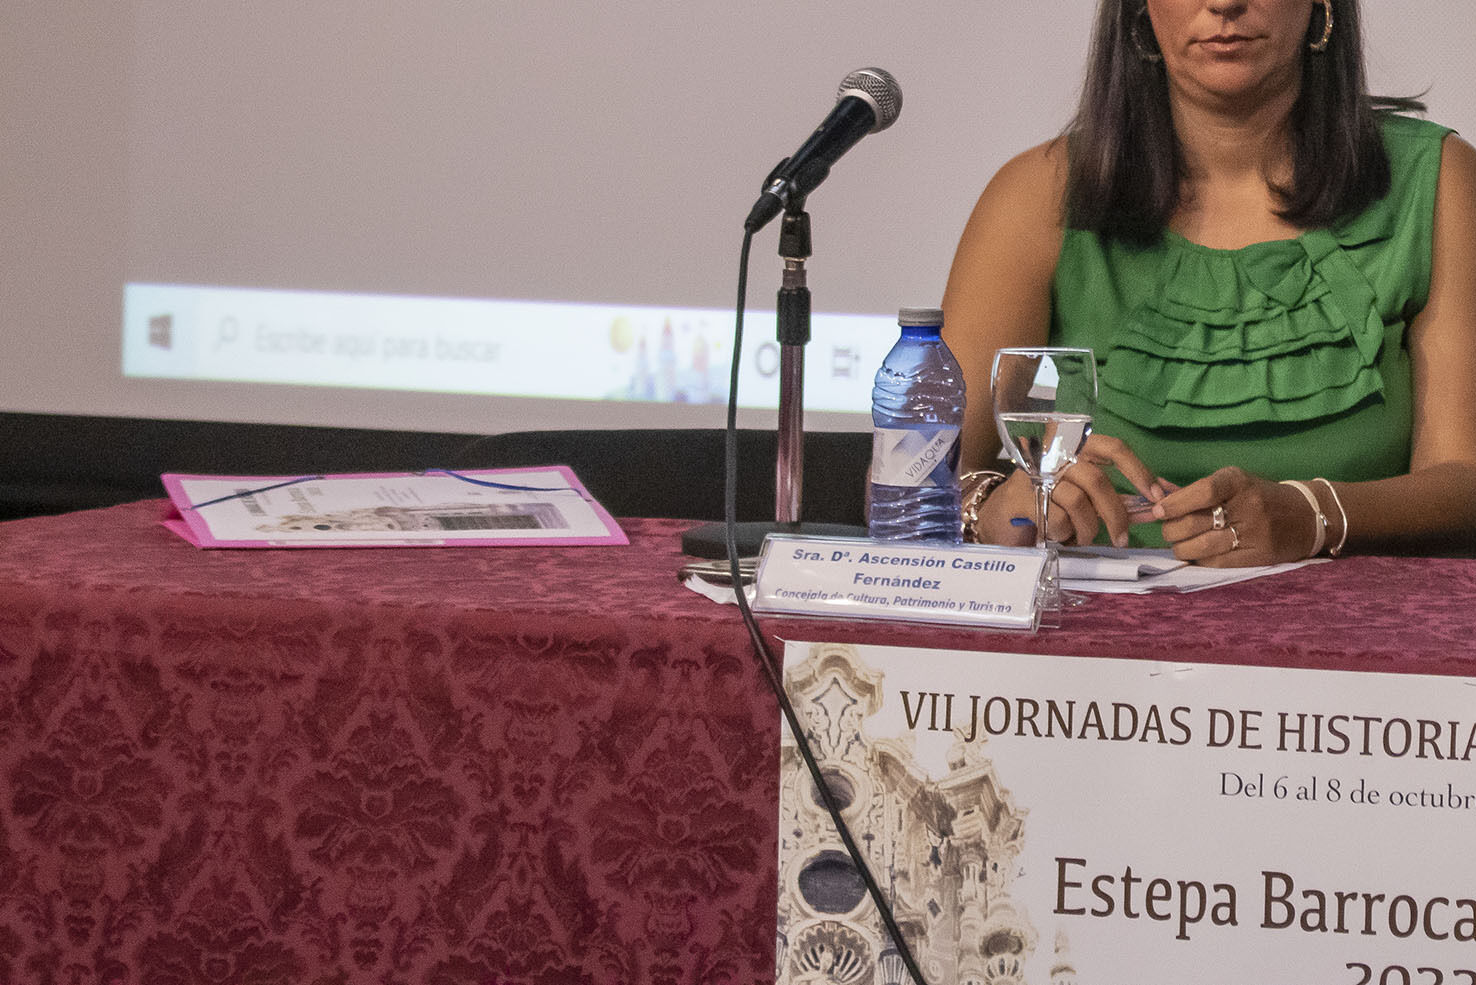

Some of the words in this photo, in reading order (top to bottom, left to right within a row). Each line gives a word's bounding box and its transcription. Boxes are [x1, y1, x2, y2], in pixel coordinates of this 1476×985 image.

[792, 548, 825, 561] Sra.
[858, 552, 945, 569] Ascensión
[951, 557, 1016, 573] Castillo
[853, 572, 941, 590] Fernández
[893, 596, 956, 609] Patrimonio
[959, 602, 966, 611] y
[899, 690, 955, 733] VII
[963, 695, 1192, 746] JORNADAS
[1206, 708, 1263, 750] DE
[1221, 772, 1264, 798] Del
[1273, 775, 1288, 799] 6
[1295, 776, 1317, 801] al
[1326, 779, 1342, 802] 8
[1349, 778, 1380, 805] de
[1052, 856, 1239, 941] Estepa
